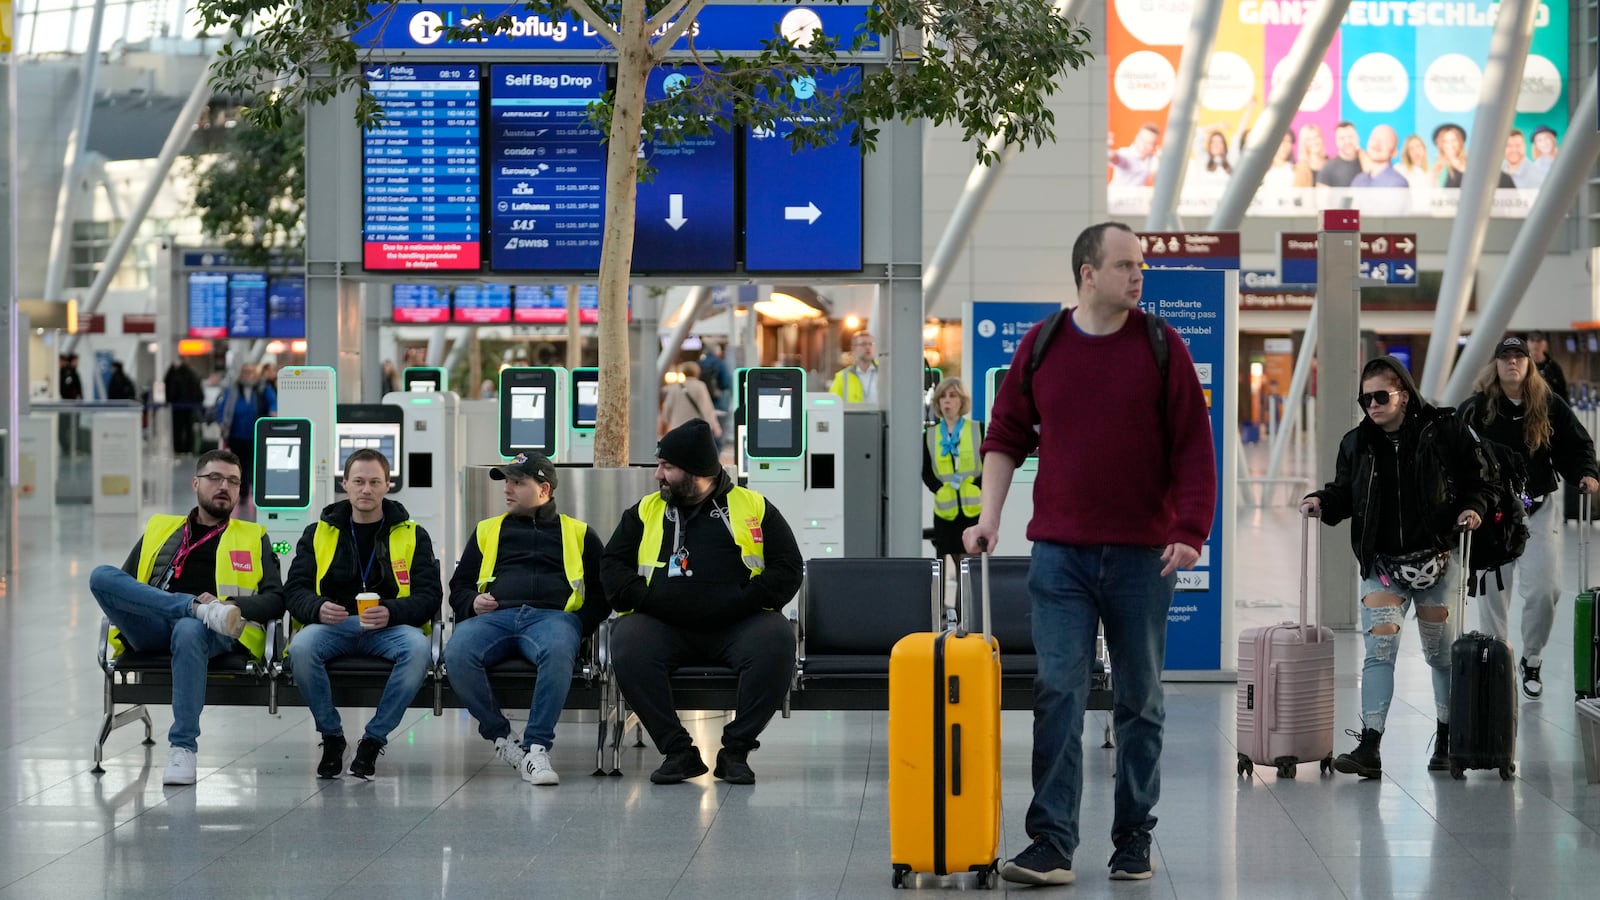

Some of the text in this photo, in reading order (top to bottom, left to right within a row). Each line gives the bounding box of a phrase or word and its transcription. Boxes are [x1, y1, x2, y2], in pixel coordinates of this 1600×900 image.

[389, 66, 414, 75] Abflug
[468, 69, 476, 78] 2
[505, 74, 593, 88] Self Bag Drop
[800, 82, 807, 91] 2
[502, 129, 536, 137] Austrian
[504, 147, 536, 156] condor
[502, 167, 540, 176] Eurowings
[512, 203, 550, 211] Lufthansa
[510, 219, 537, 231] SAS
[518, 239, 550, 248] SWISS
[1160, 300, 1202, 309] Bordkarte
[1160, 310, 1217, 320] Boarding pass
[233, 561, 252, 570] ver.di
